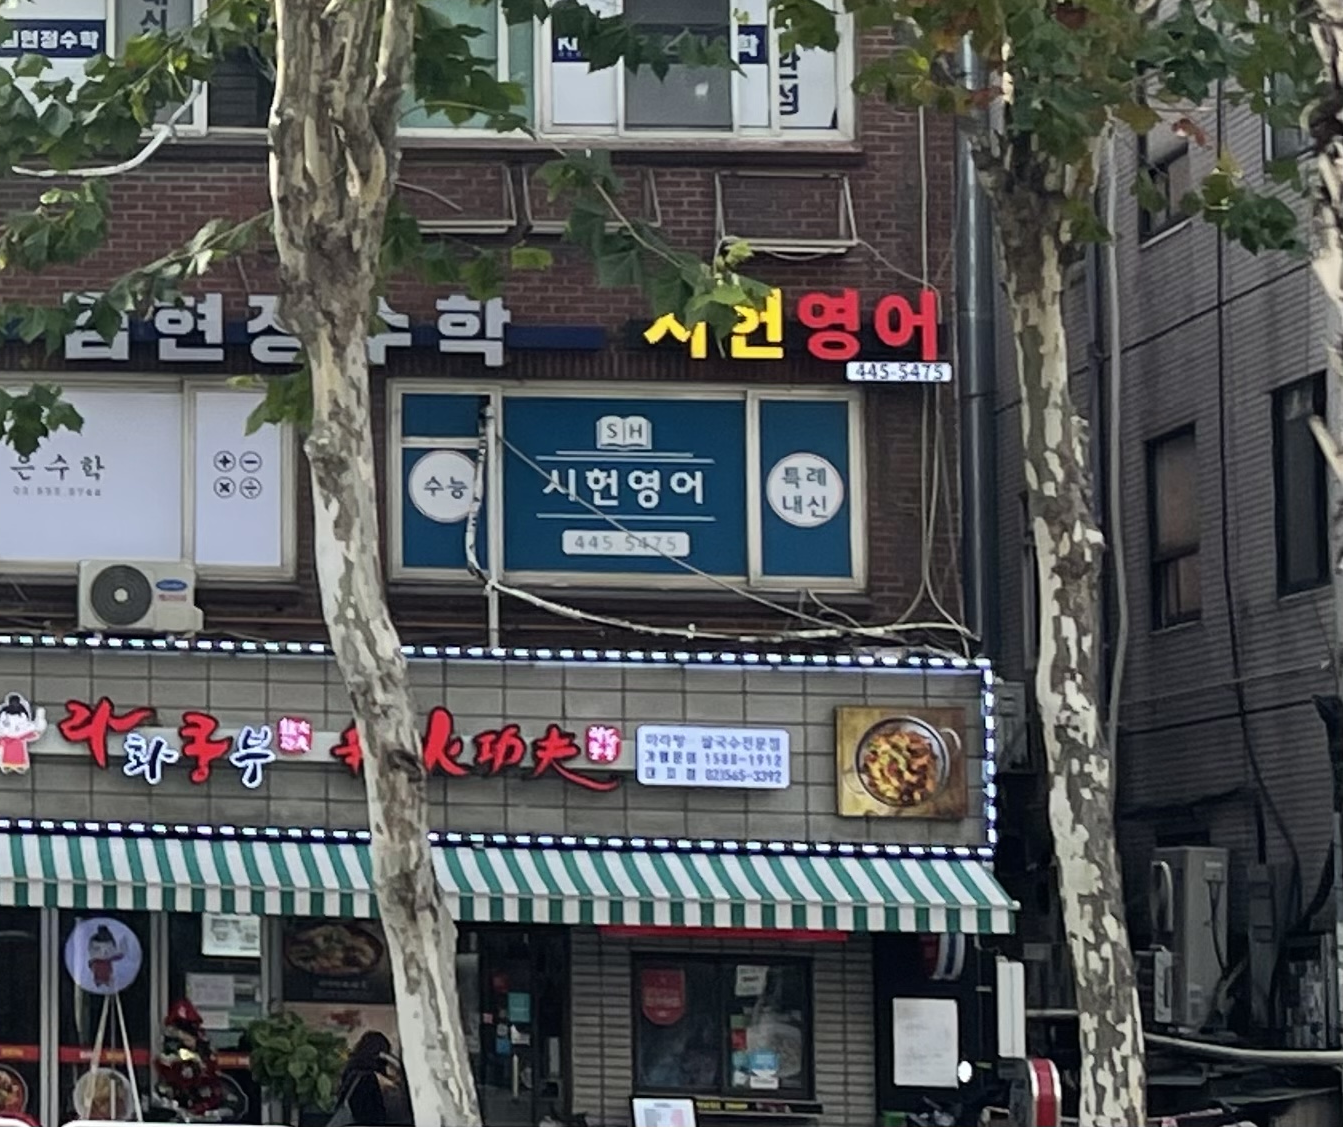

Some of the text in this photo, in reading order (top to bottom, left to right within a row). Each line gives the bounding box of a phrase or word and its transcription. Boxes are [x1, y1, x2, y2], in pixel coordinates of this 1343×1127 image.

[2, 29, 100, 50] 현정수학
[854, 363, 944, 380] 445-5475
[422, 474, 466, 499] 수능
[542, 468, 704, 508] 시헌영어
[781, 466, 827, 490] 특례
[781, 494, 829, 520] 내신
